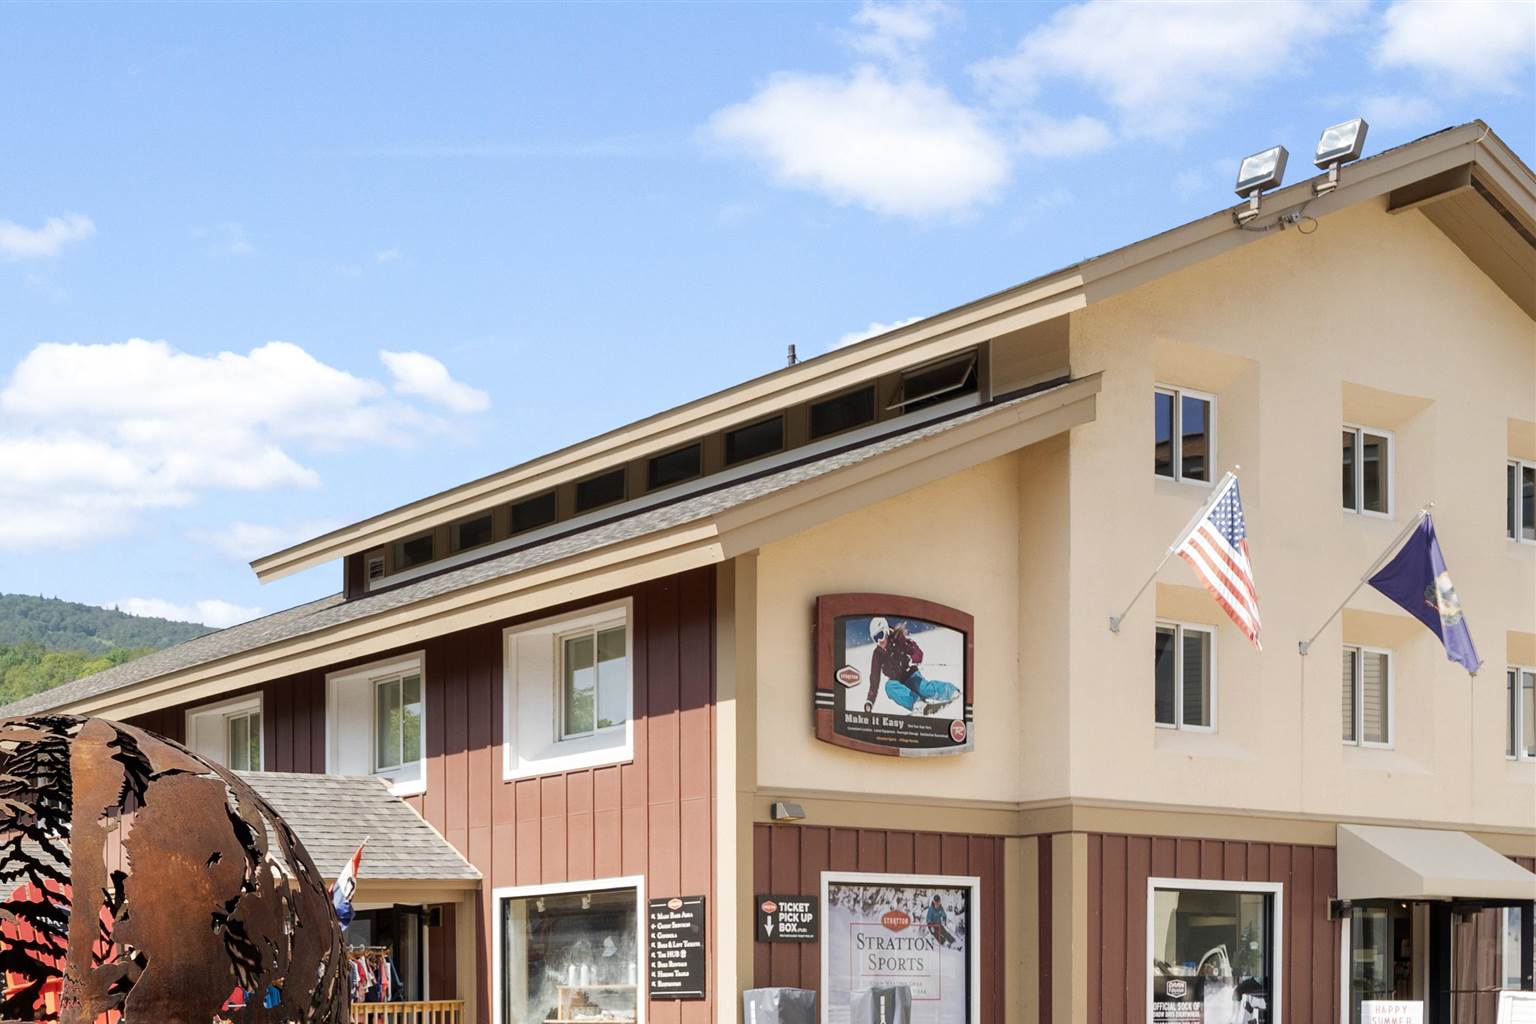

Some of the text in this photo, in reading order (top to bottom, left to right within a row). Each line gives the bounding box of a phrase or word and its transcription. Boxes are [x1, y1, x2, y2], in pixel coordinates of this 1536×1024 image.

[882, 717, 904, 729] Easy
[778, 902, 810, 912] TICKET
[778, 912, 813, 923] PICK UP
[779, 923, 797, 932] BOX
[857, 932, 934, 950] STRATTON
[868, 953, 924, 971] SPORTS
[1375, 1005, 1408, 1014] HAPPY
